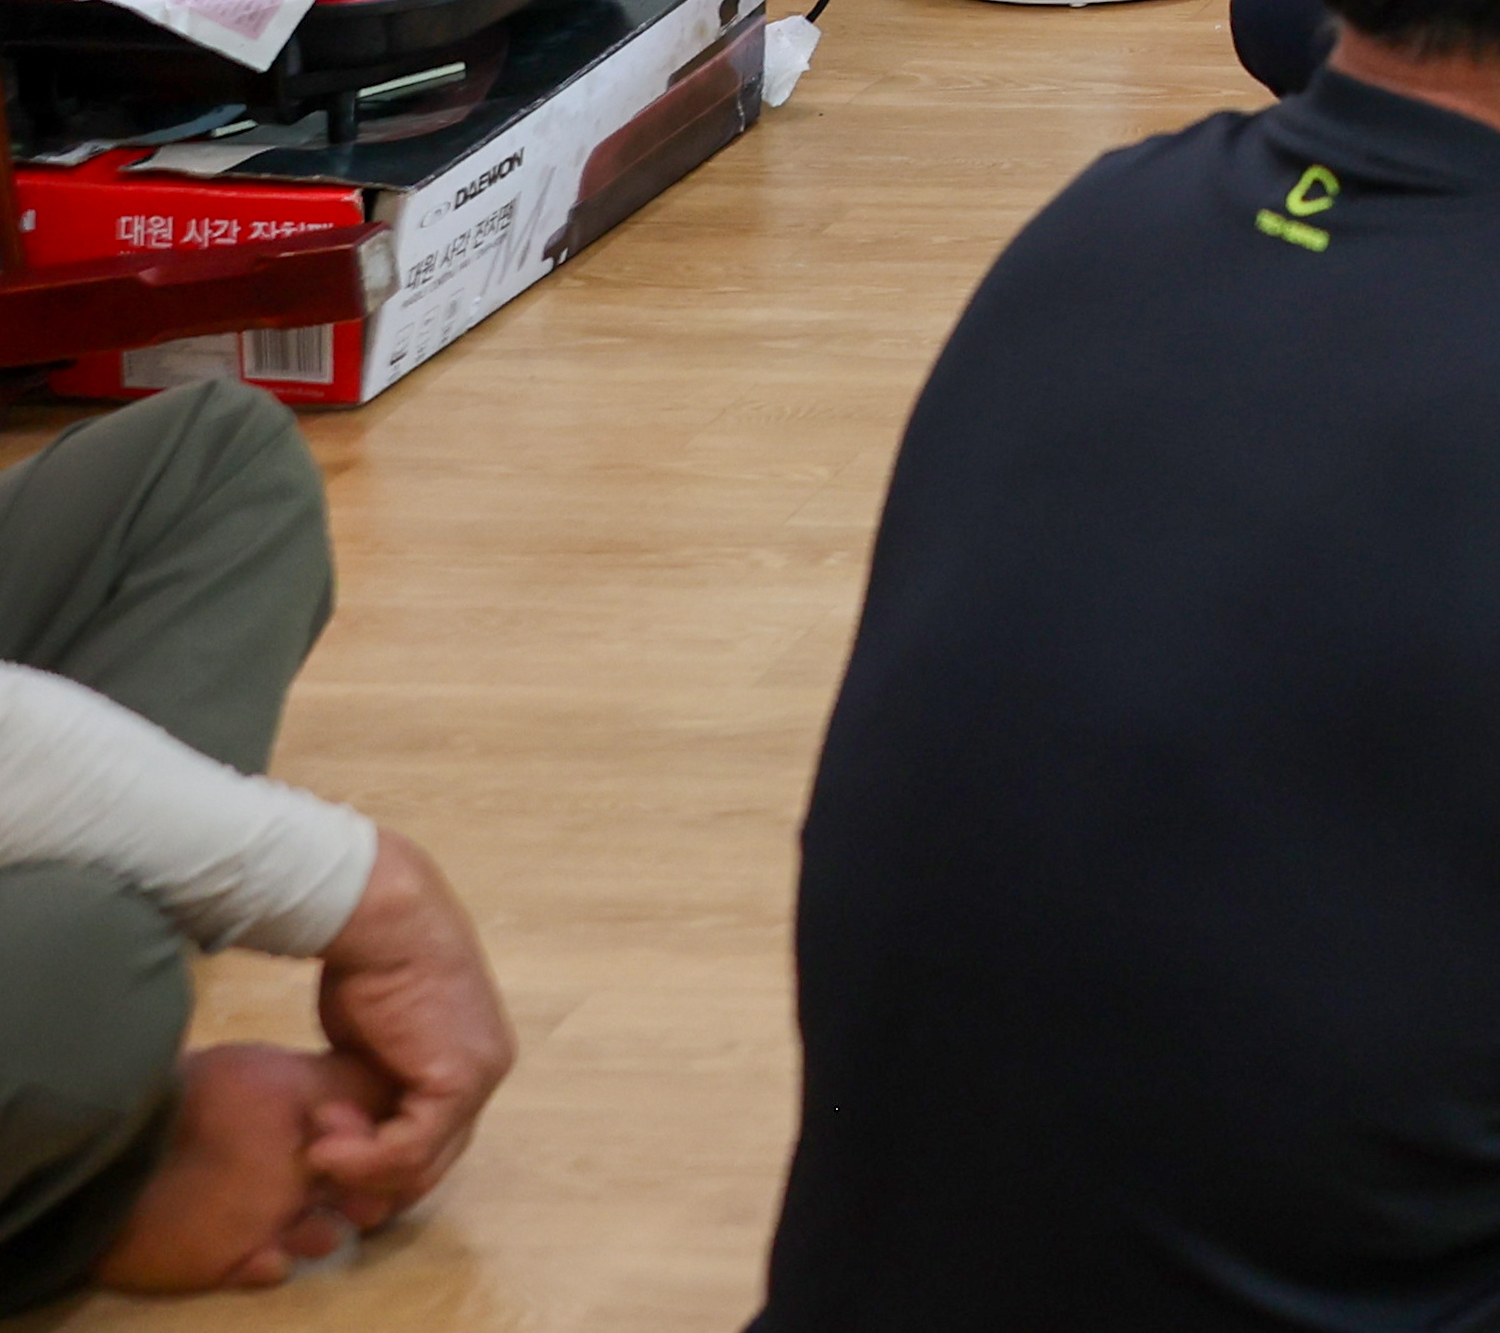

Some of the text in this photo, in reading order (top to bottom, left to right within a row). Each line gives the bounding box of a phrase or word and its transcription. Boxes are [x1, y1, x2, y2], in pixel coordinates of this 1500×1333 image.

[454, 147, 525, 211] DAEWON
[117, 214, 174, 249] 대원
[405, 250, 438, 290] 대원
